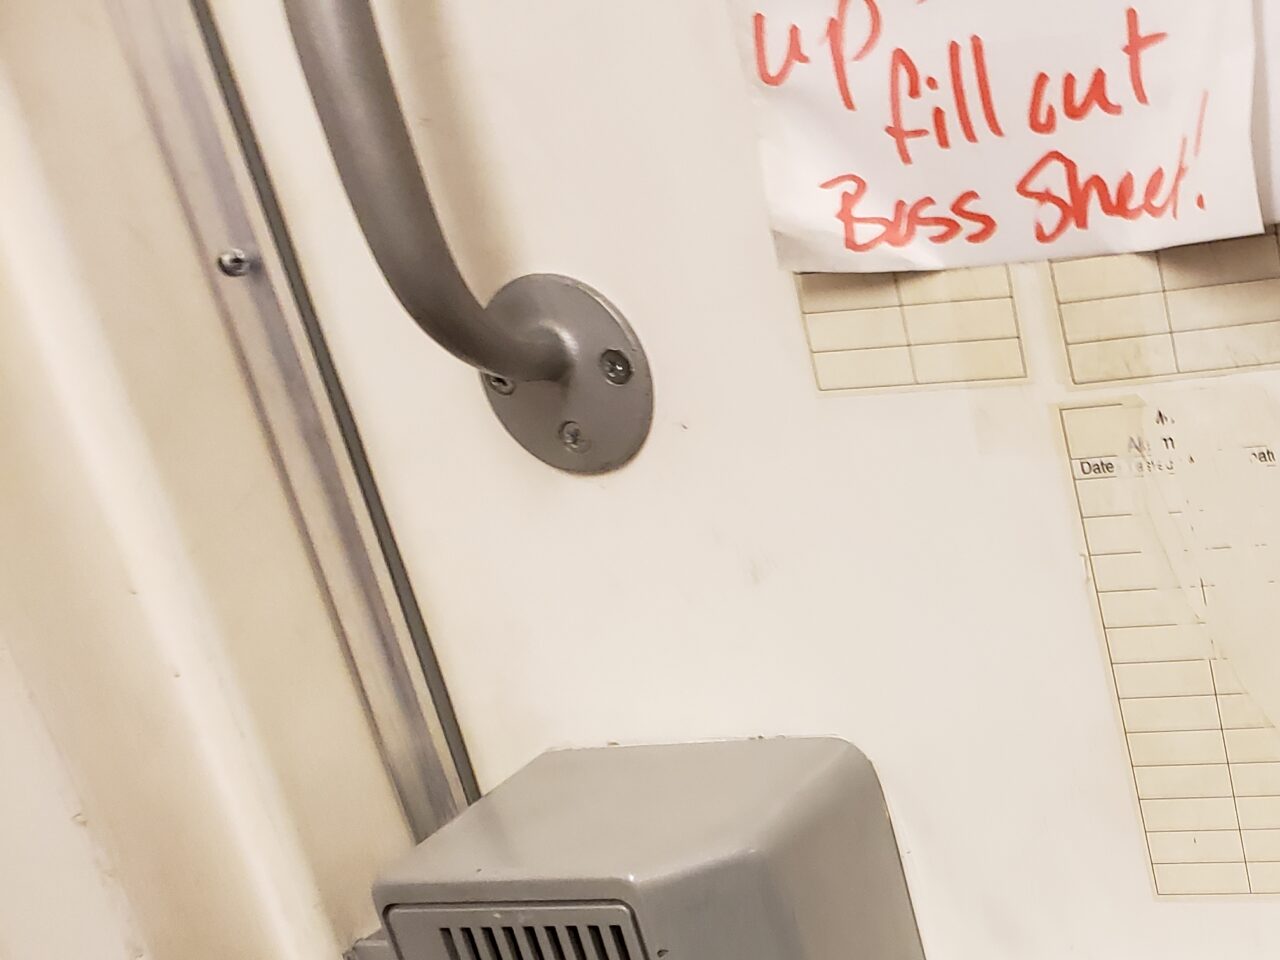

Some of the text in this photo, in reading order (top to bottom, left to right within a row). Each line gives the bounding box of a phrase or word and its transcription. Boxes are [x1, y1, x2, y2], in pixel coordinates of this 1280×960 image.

[885, 7, 1167, 164] fill out
[1080, 460, 1114, 475] Date
